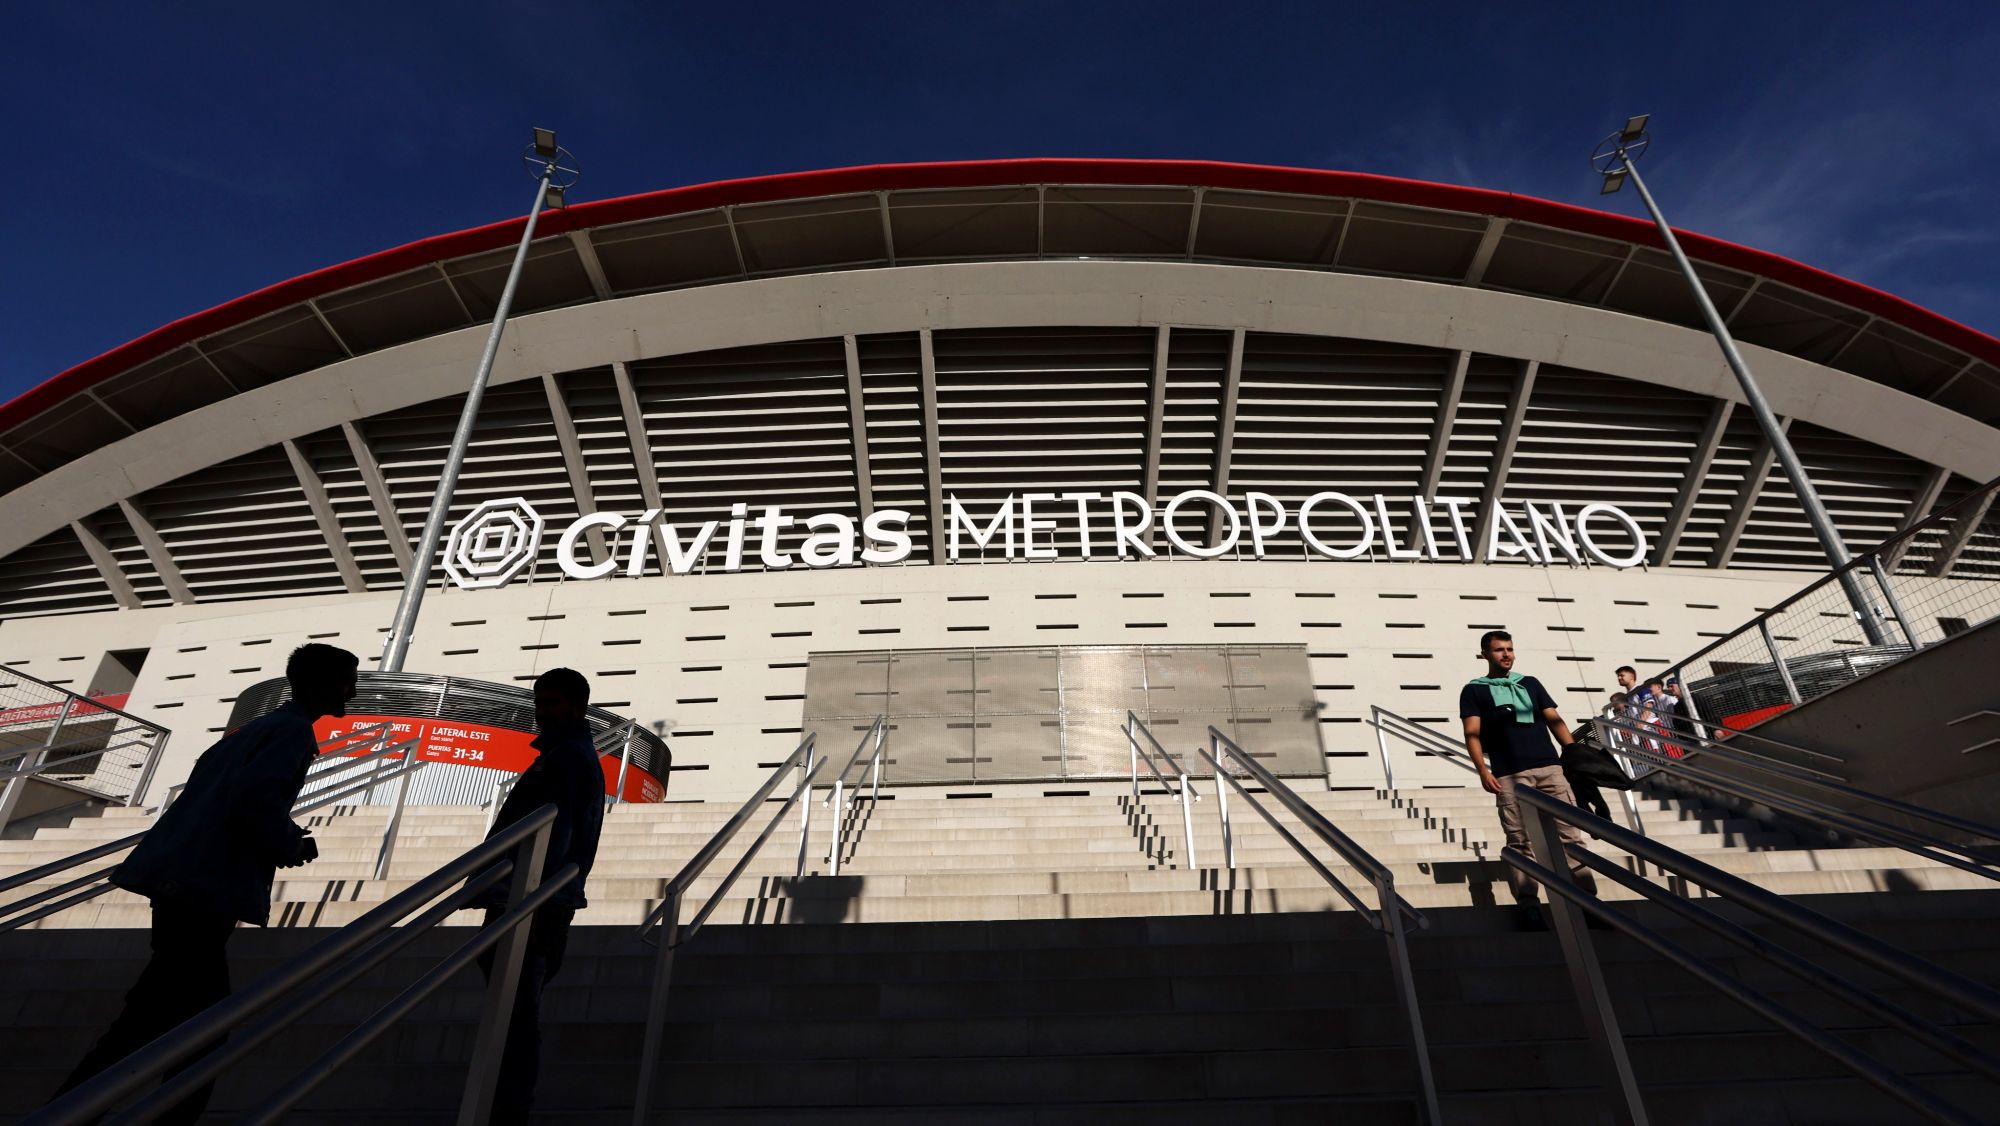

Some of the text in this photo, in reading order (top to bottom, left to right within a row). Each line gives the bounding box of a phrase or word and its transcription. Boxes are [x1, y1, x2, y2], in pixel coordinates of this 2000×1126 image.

[555, 489, 1648, 580] Cívitas METROPOLITANO
[389, 723, 412, 732] ORTE
[432, 726, 491, 741] LATERAL ESTE
[427, 744, 484, 761] PUERTAS 31-34
